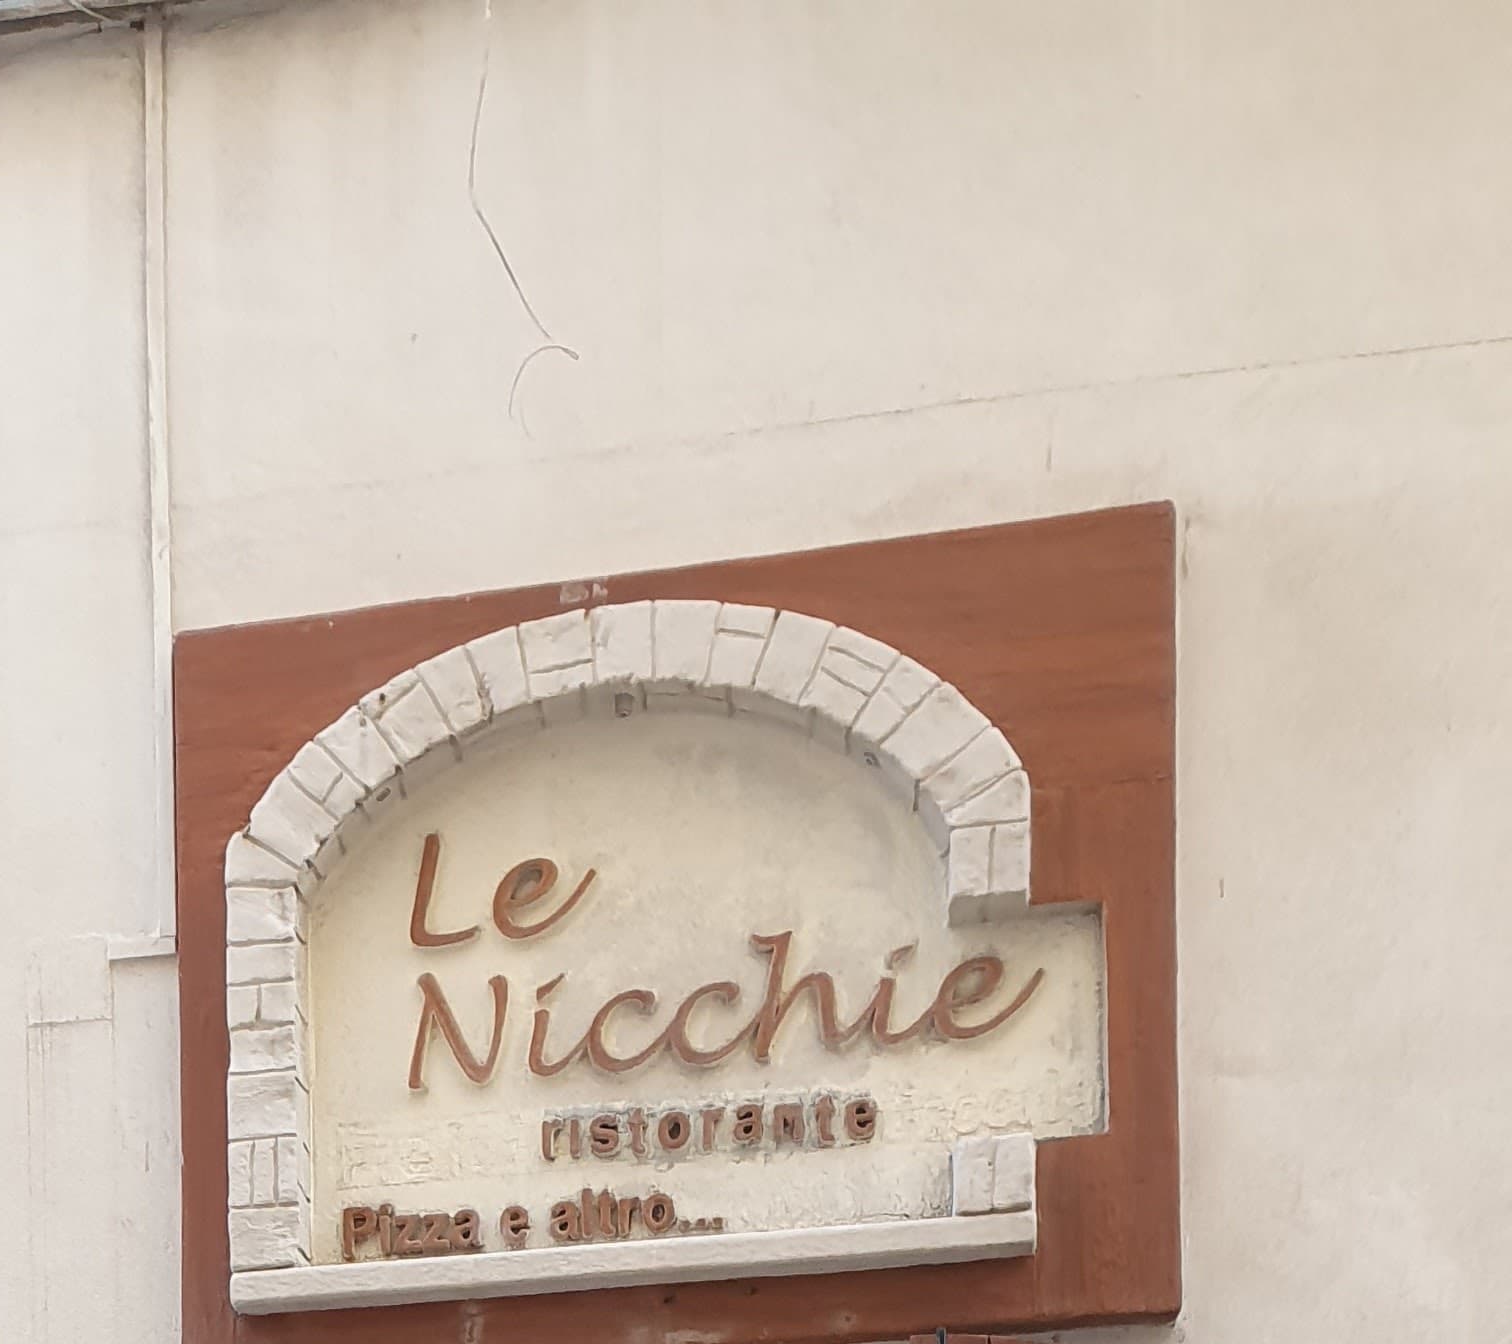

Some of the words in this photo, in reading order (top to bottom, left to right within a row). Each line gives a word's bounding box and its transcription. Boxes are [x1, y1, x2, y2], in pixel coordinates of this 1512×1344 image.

[408, 832, 599, 949] Le
[408, 931, 1046, 1091] Nicchie
[541, 1096, 879, 1162] ristorante
[342, 1202, 484, 1261] Pizza
[500, 1206, 530, 1249] e
